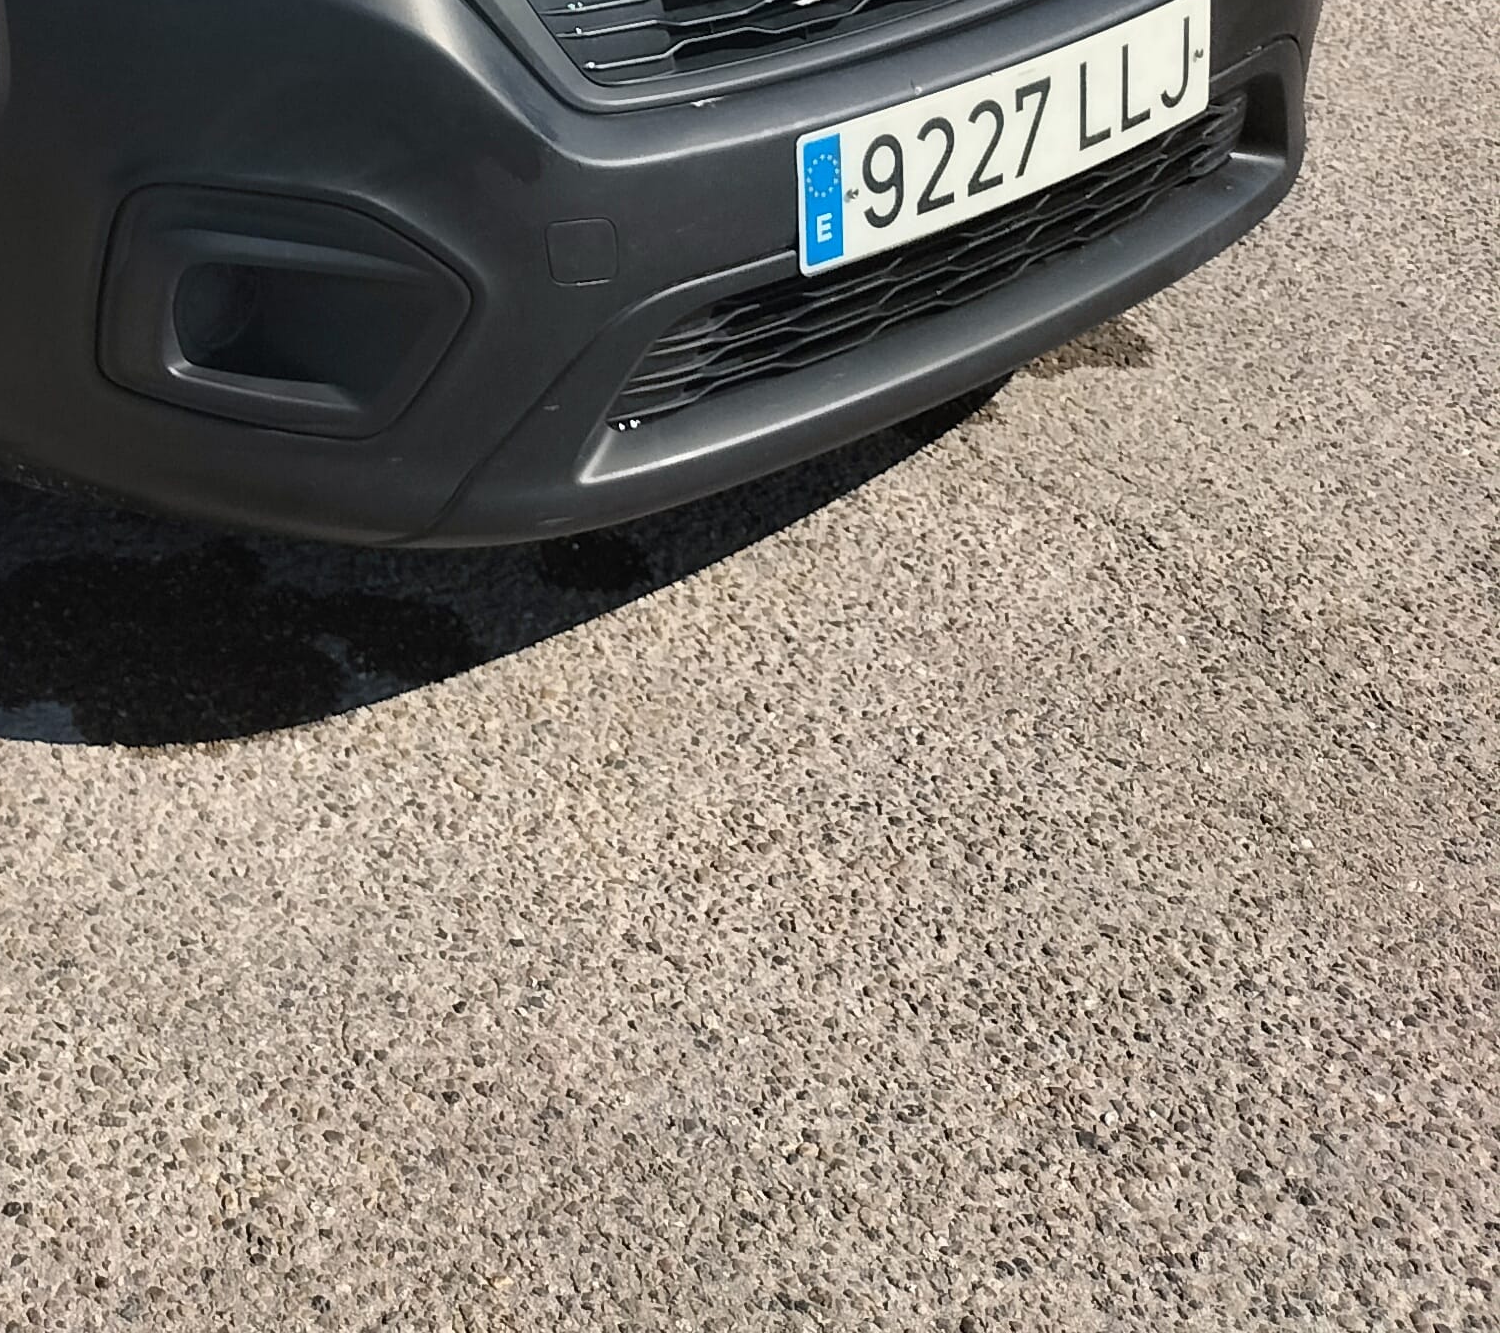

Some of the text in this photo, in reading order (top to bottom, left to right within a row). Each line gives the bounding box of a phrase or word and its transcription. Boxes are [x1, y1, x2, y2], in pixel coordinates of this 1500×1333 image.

[862, 15, 1190, 229] 9227 LLJ
[816, 212, 833, 243] E
